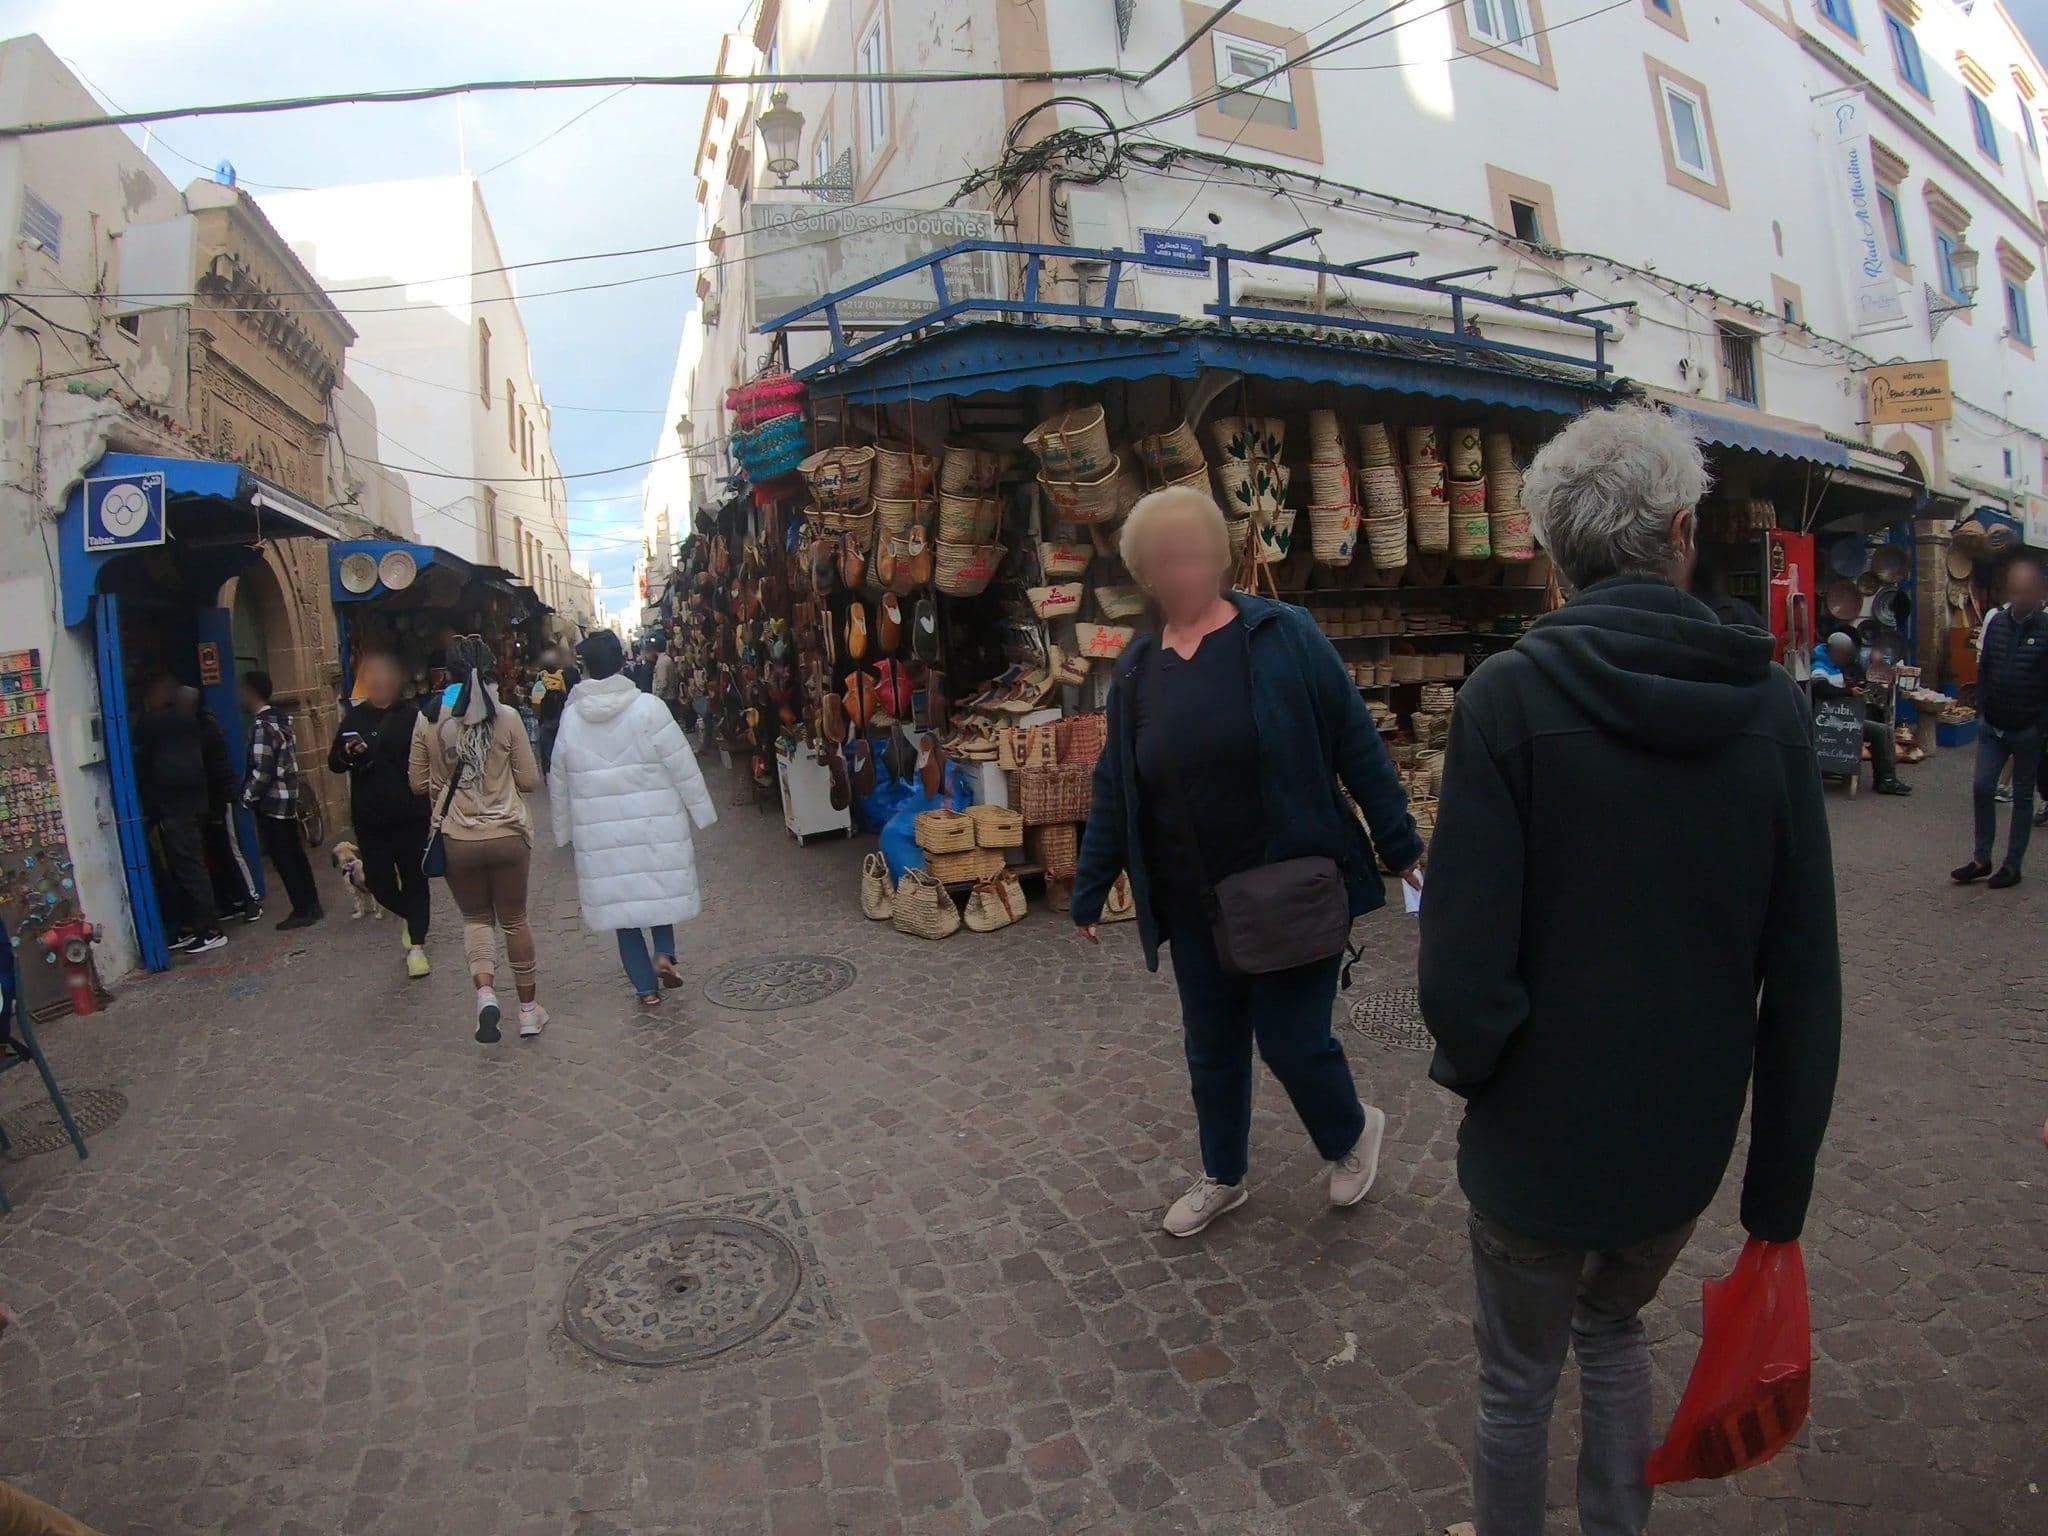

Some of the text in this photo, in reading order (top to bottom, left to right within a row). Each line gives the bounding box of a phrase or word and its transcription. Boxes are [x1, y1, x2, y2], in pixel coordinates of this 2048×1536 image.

[1846, 148, 1868, 208] Madina
[790, 209, 837, 234] Coin
[841, 210, 877, 232] Des
[882, 211, 986, 238] Babouches
[1862, 239, 1883, 278] Riad
[89, 536, 115, 546] Tabac
